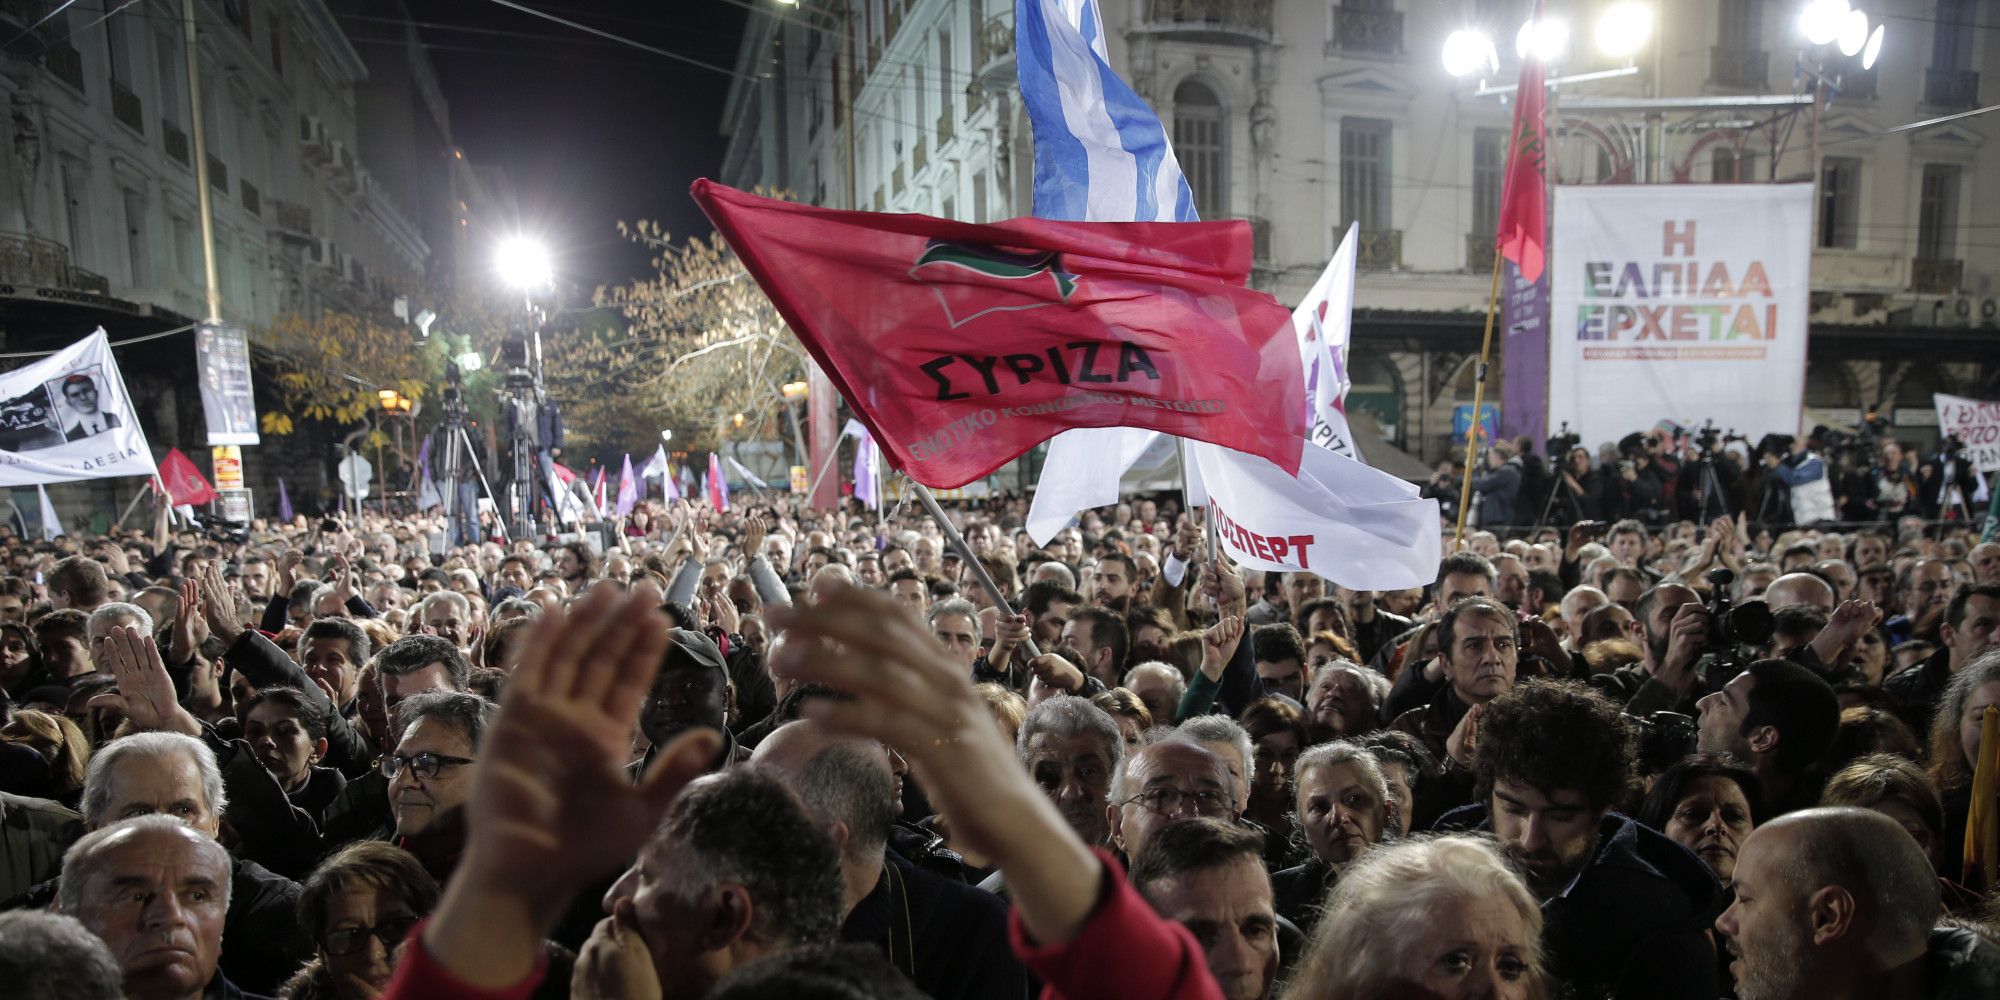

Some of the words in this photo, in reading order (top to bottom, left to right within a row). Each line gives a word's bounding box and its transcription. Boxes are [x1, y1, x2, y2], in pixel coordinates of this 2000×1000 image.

[1663, 220, 1696, 256] Η
[1584, 261, 1773, 298] ΕΛΠΙΔΑ
[1577, 304, 1777, 341] ΕΡΧΕΤΑΙ
[920, 341, 1159, 400] ΣΥΡΙΖΑ
[907, 408, 997, 462] ΕΝΩΤΙΚΟ
[1313, 414, 1352, 458] ΥΡΙΖ
[83, 448, 137, 470] ΔΕΞΙΑ
